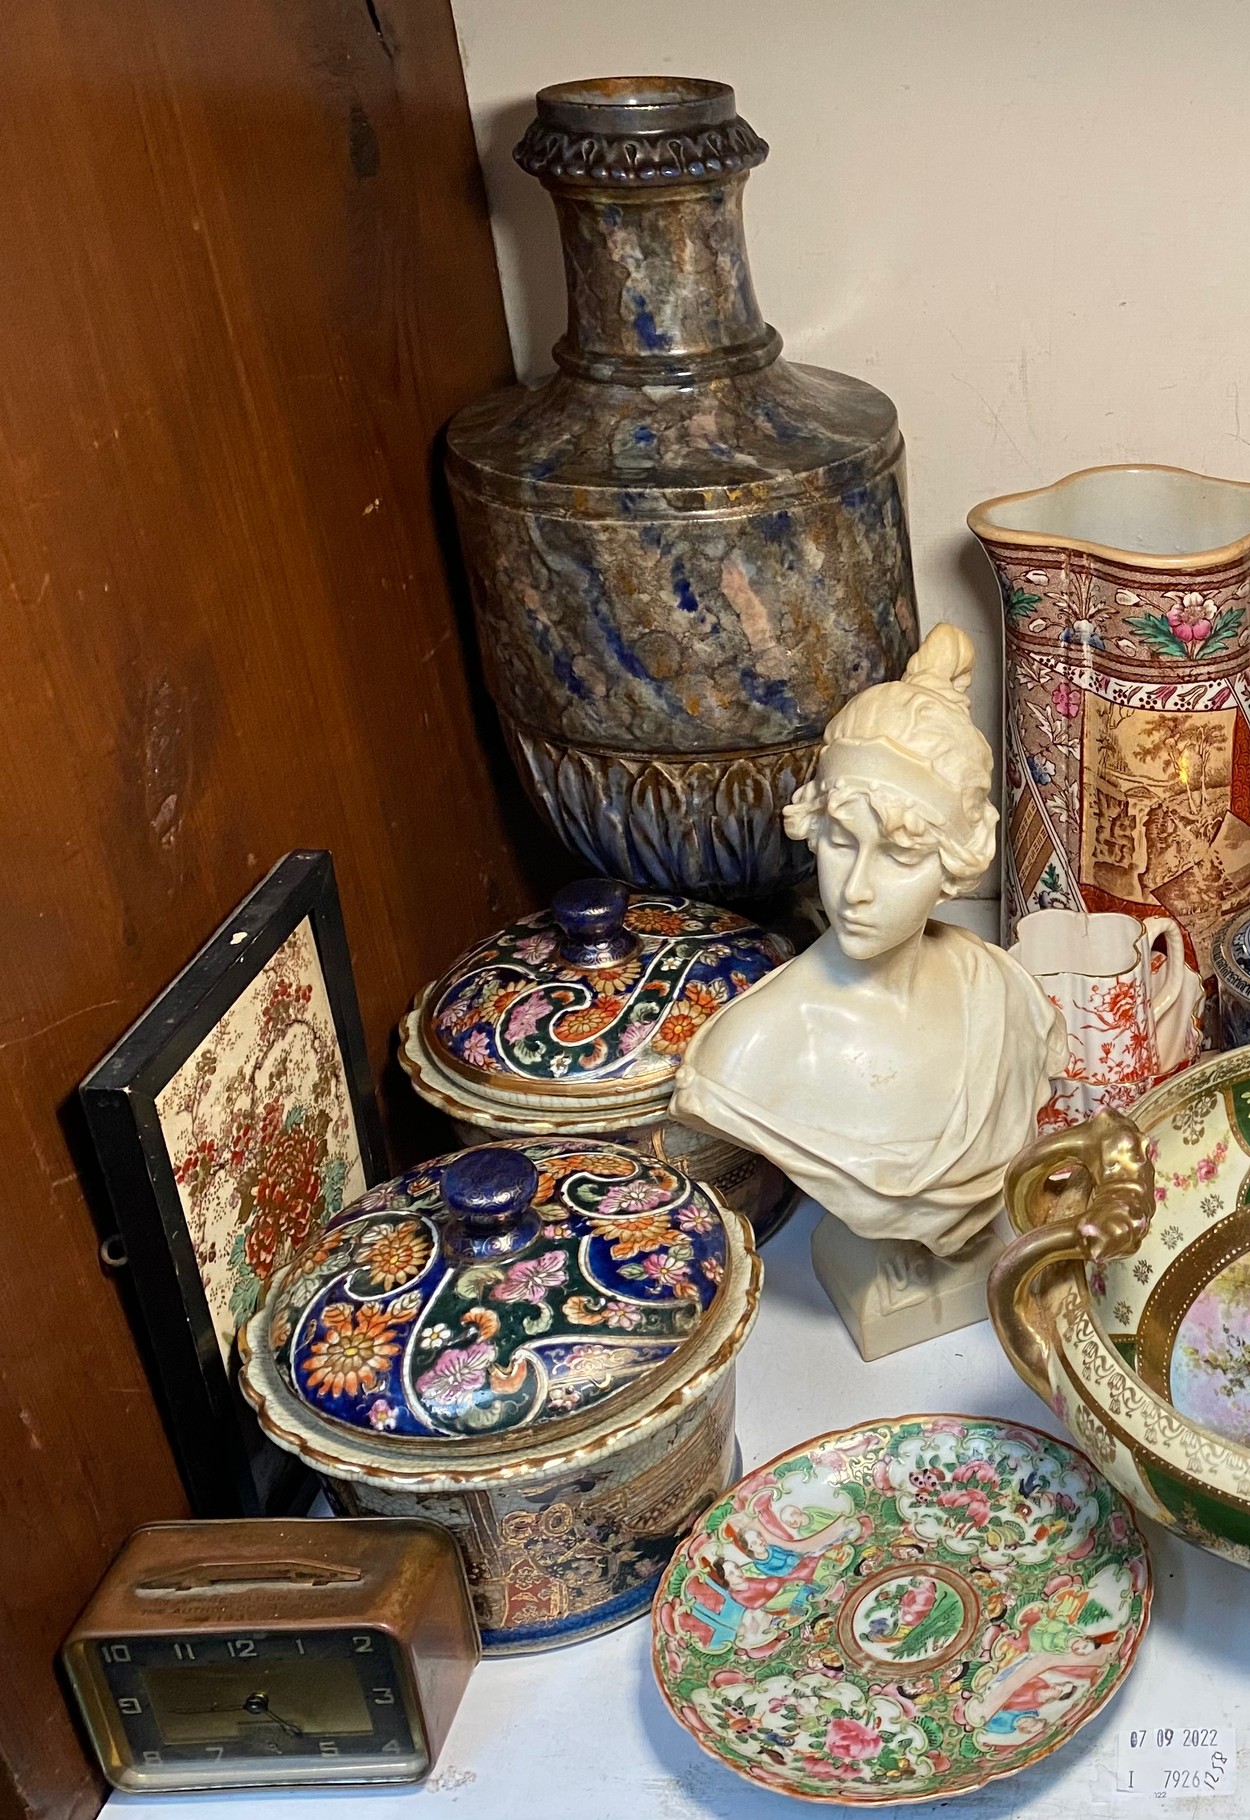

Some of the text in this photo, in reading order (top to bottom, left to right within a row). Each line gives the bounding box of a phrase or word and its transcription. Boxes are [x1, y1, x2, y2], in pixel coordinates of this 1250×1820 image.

[101, 1636, 374, 1663] 10 11 12 1 2
[372, 1687, 395, 1705] 3
[119, 1698, 142, 1714] 9
[1130, 1728, 1218, 1748] 07 09 2022
[205, 1747, 223, 1763] 7
[318, 1741, 339, 1757] 5
[1163, 1770, 1201, 1789] 7926
